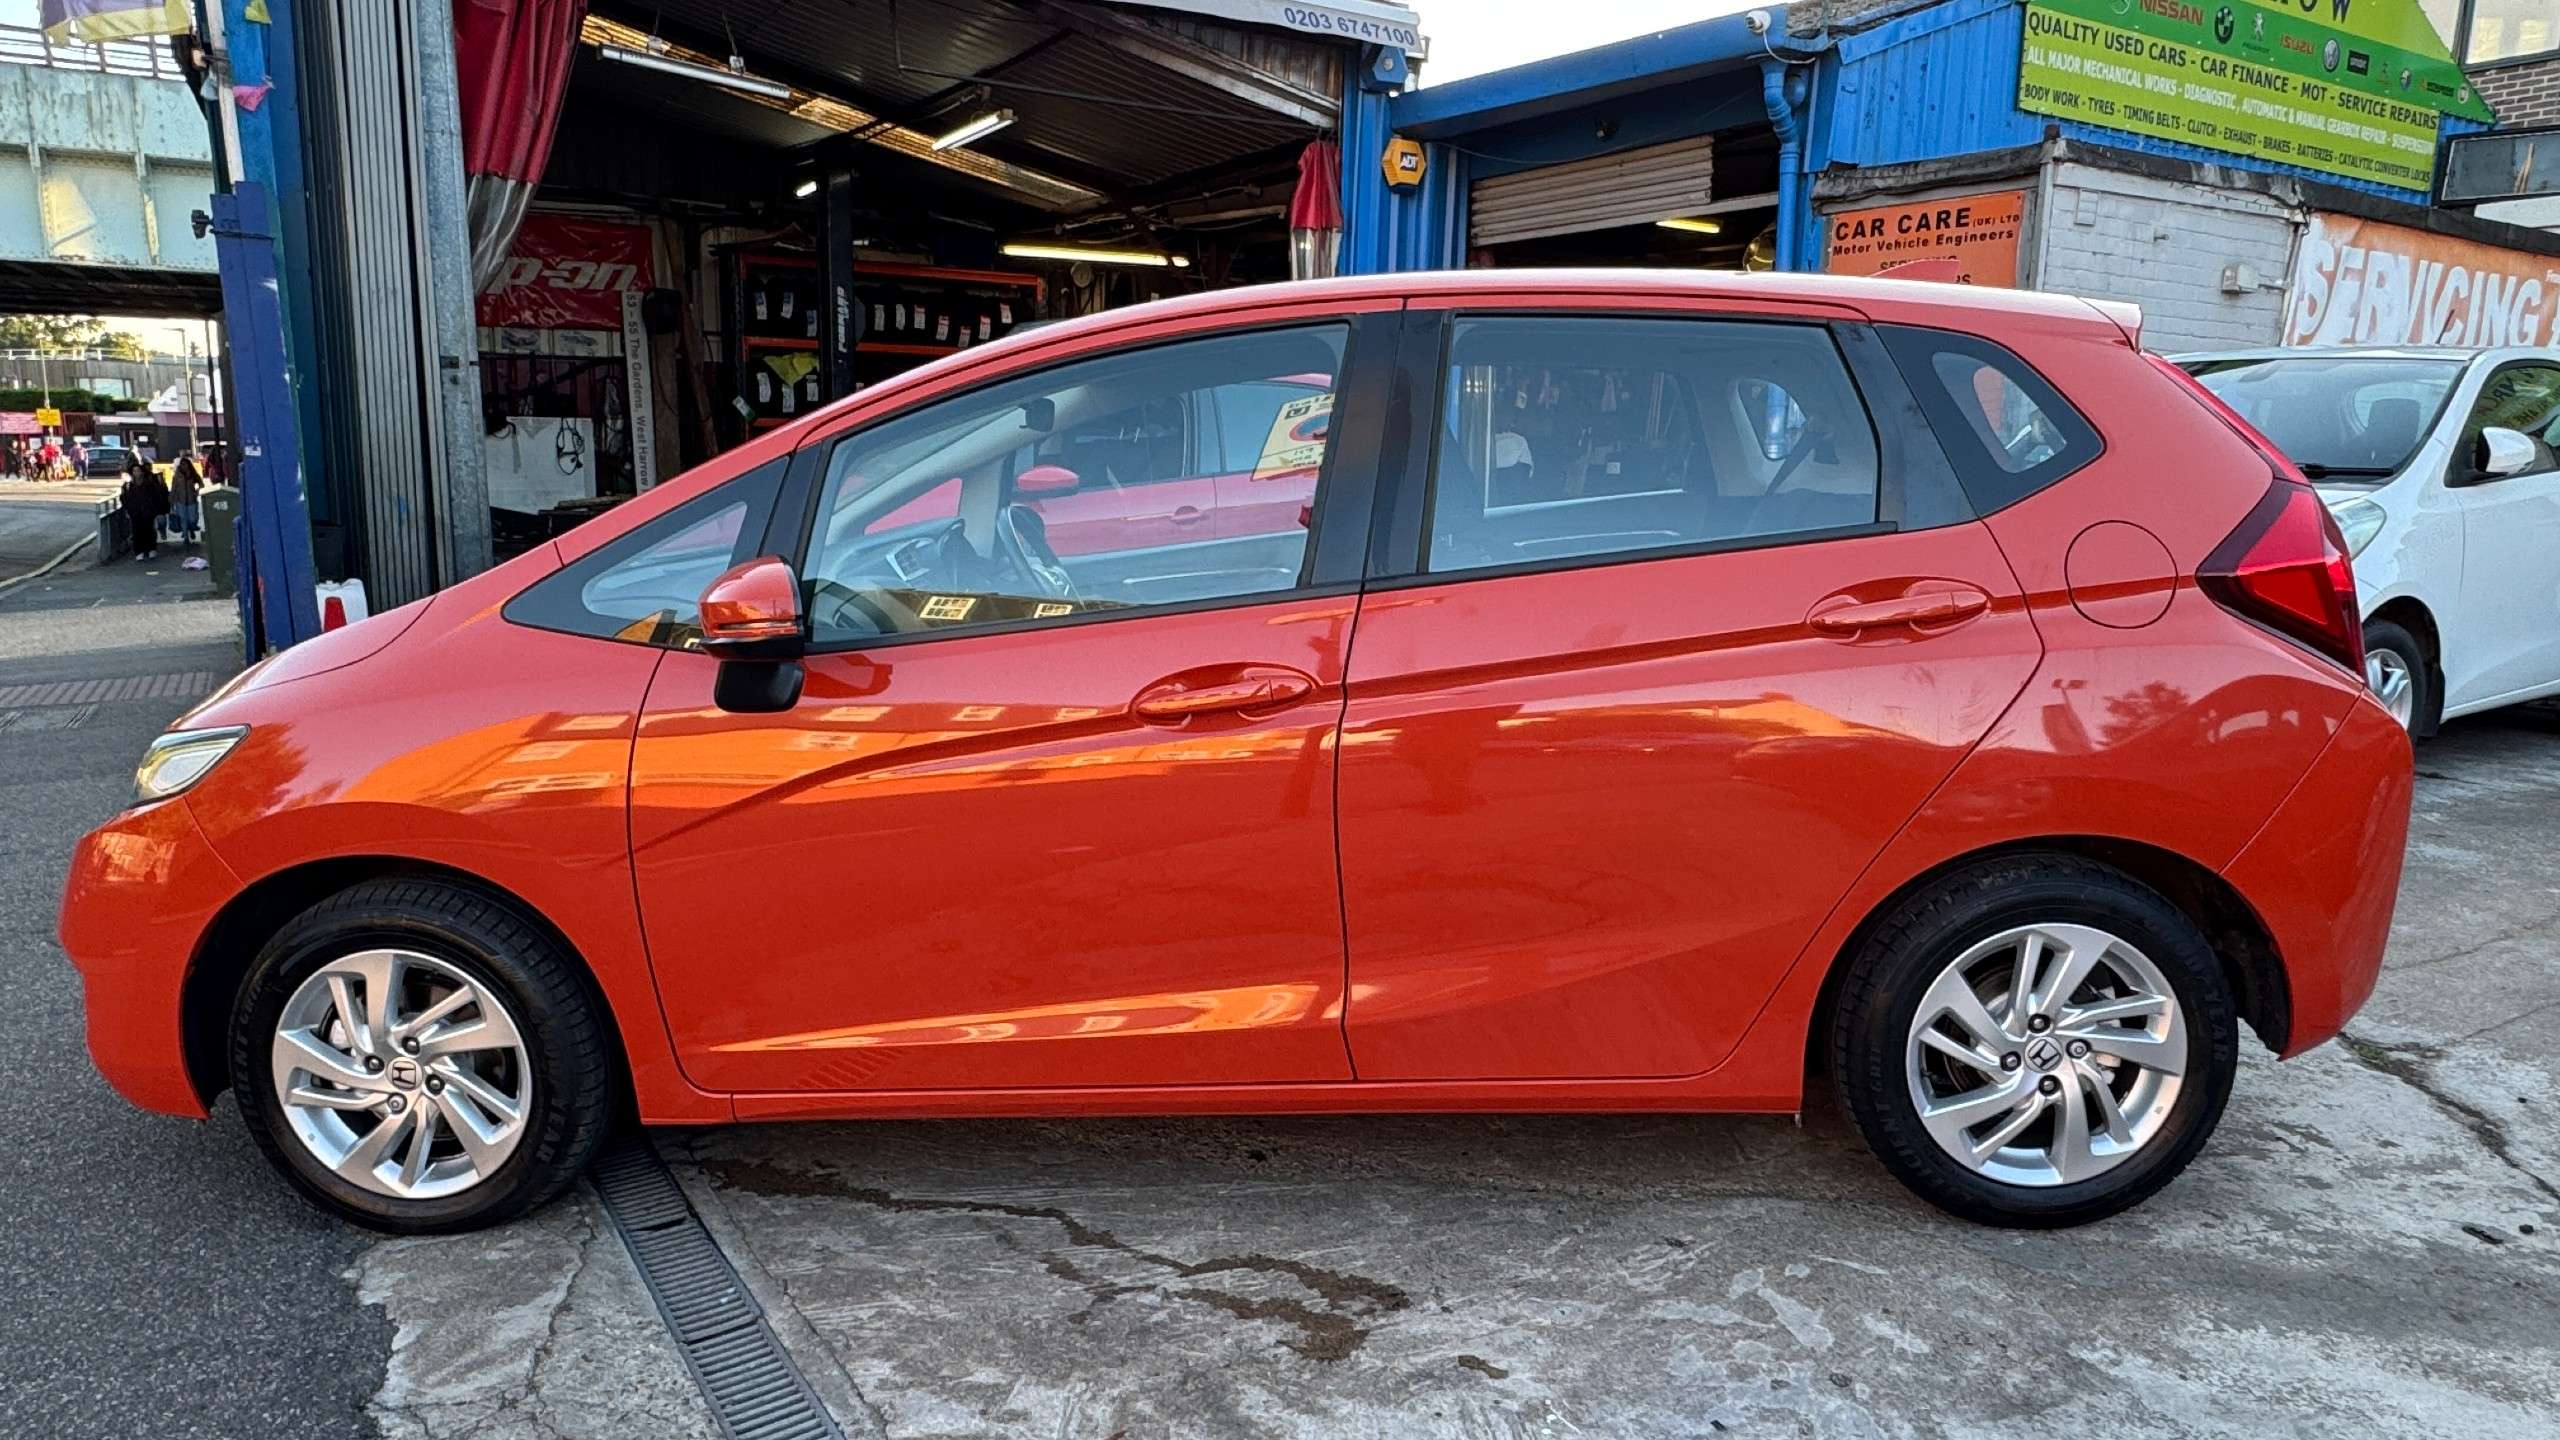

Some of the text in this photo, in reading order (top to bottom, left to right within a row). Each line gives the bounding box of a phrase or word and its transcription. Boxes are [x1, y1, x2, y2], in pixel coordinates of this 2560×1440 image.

[1284, 7, 1415, 46] 0203 6747100
[2140, 0, 2204, 26] NISSAN
[2026, 46, 2046, 66] ALL
[2047, 50, 2081, 75] MAJOR
[2083, 58, 2143, 88] MECHANICAL
[2144, 71, 2177, 96] WORKS
[2242, 97, 2288, 122] AUTOMATIC
[2028, 11, 2100, 46] QUALITY
[2104, 30, 2145, 57] USED
[2148, 42, 2187, 67] CARS
[2200, 56, 2228, 78] CAR
[2232, 64, 2289, 93] FINANCE
[2300, 82, 2328, 103] MOT
[2338, 92, 2387, 118] SERVICE
[2389, 105, 2438, 130] REPAIRS
[2024, 83, 2050, 102] BODY
[2052, 89, 2081, 109] WORK
[2088, 97, 2115, 116] TYRES
[2123, 104, 2154, 124] TIMING
[2156, 111, 2181, 130] BELTS
[2187, 119, 2218, 137] CLUTCH
[2223, 127, 2257, 145] EXHAUST
[2263, 136, 2292, 153] BRAKES
[2297, 143, 2333, 161] BATTERIES
[2338, 153, 2374, 172] CATALYTIC
[2374, 160, 2411, 178] CONVERTER
[1401, 153, 1417, 169] ADT
[1835, 207, 2020, 241] CAR CARE (UK) LTD
[1833, 229, 2014, 257] Motor Vehicle Engineers
[2297, 238, 2542, 347] SERVICING
[629, 338, 640, 359] The
[636, 416, 647, 444] West
[637, 446, 649, 487] Harrow
